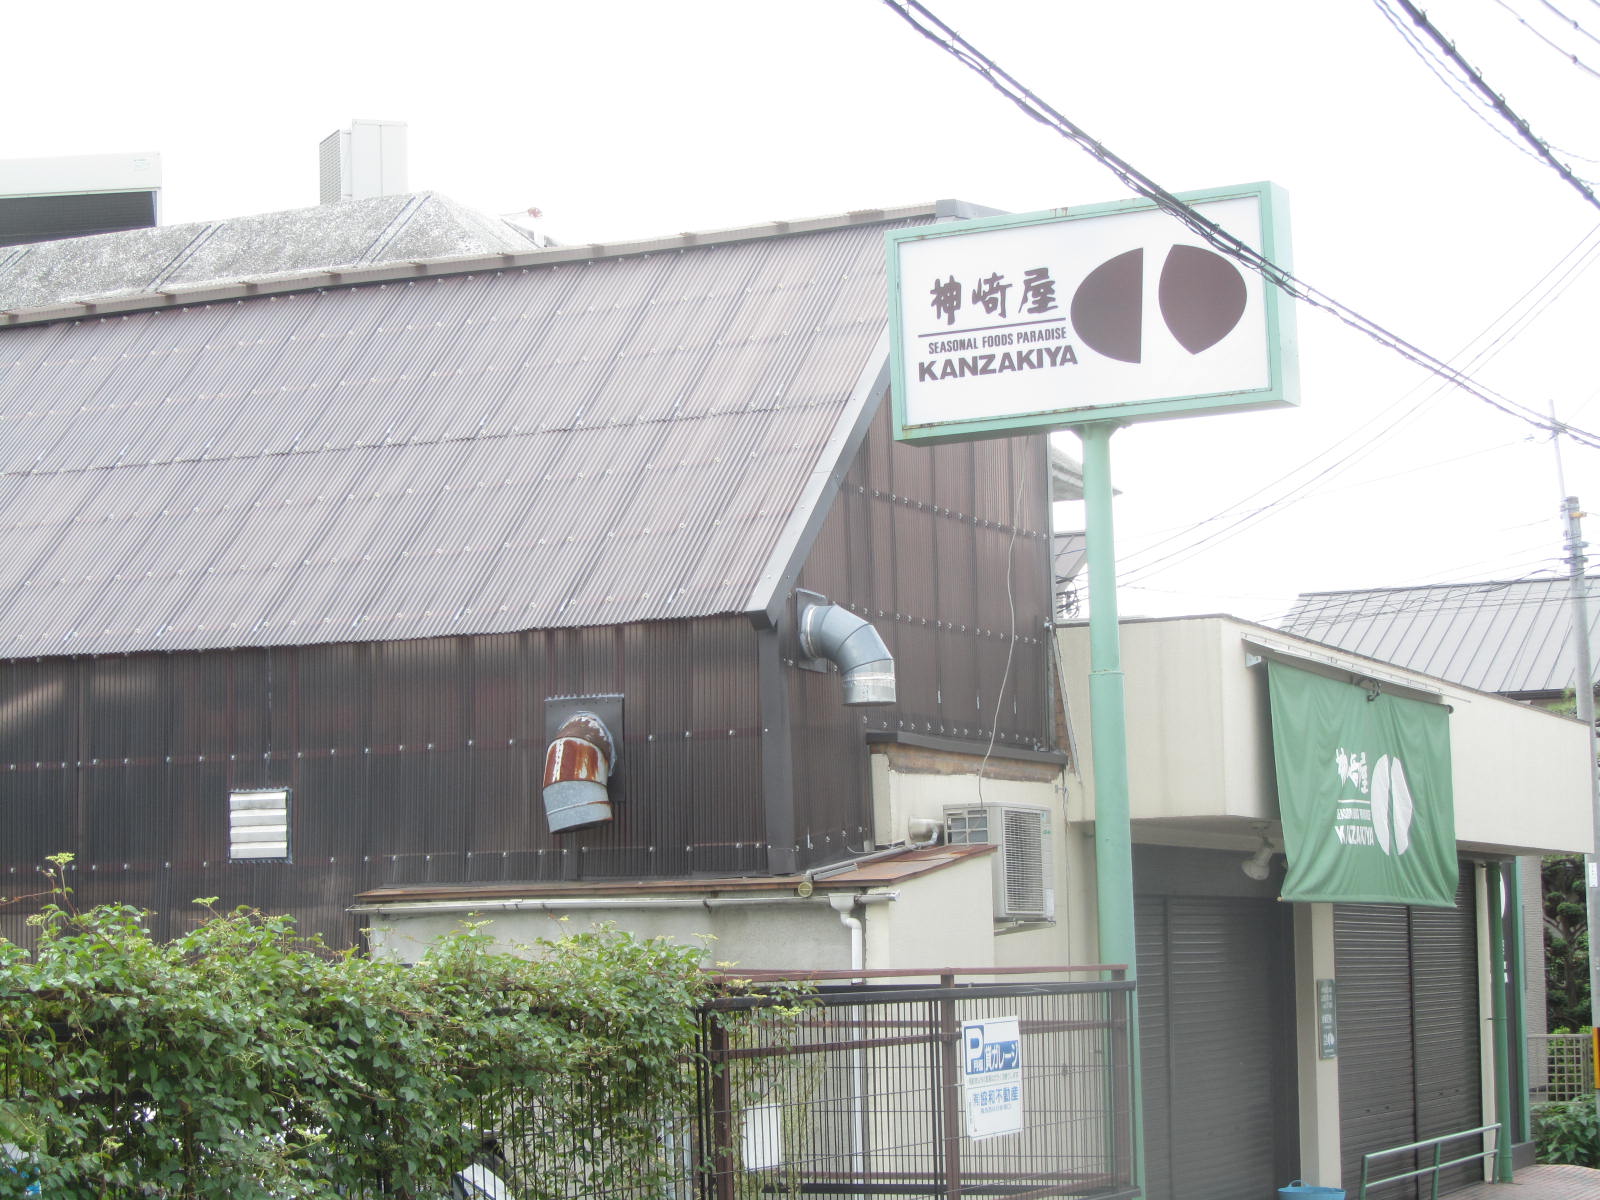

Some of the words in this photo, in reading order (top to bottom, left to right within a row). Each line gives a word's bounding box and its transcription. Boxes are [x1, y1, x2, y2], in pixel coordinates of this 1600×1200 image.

[930, 267, 1058, 326] 神崎屋
[928, 337, 979, 355] SEASONAL
[982, 333, 1014, 349] FOODS
[1017, 326, 1067, 345] PARADISE
[918, 344, 1079, 383] KANZAKIYA
[965, 1026, 984, 1073] P
